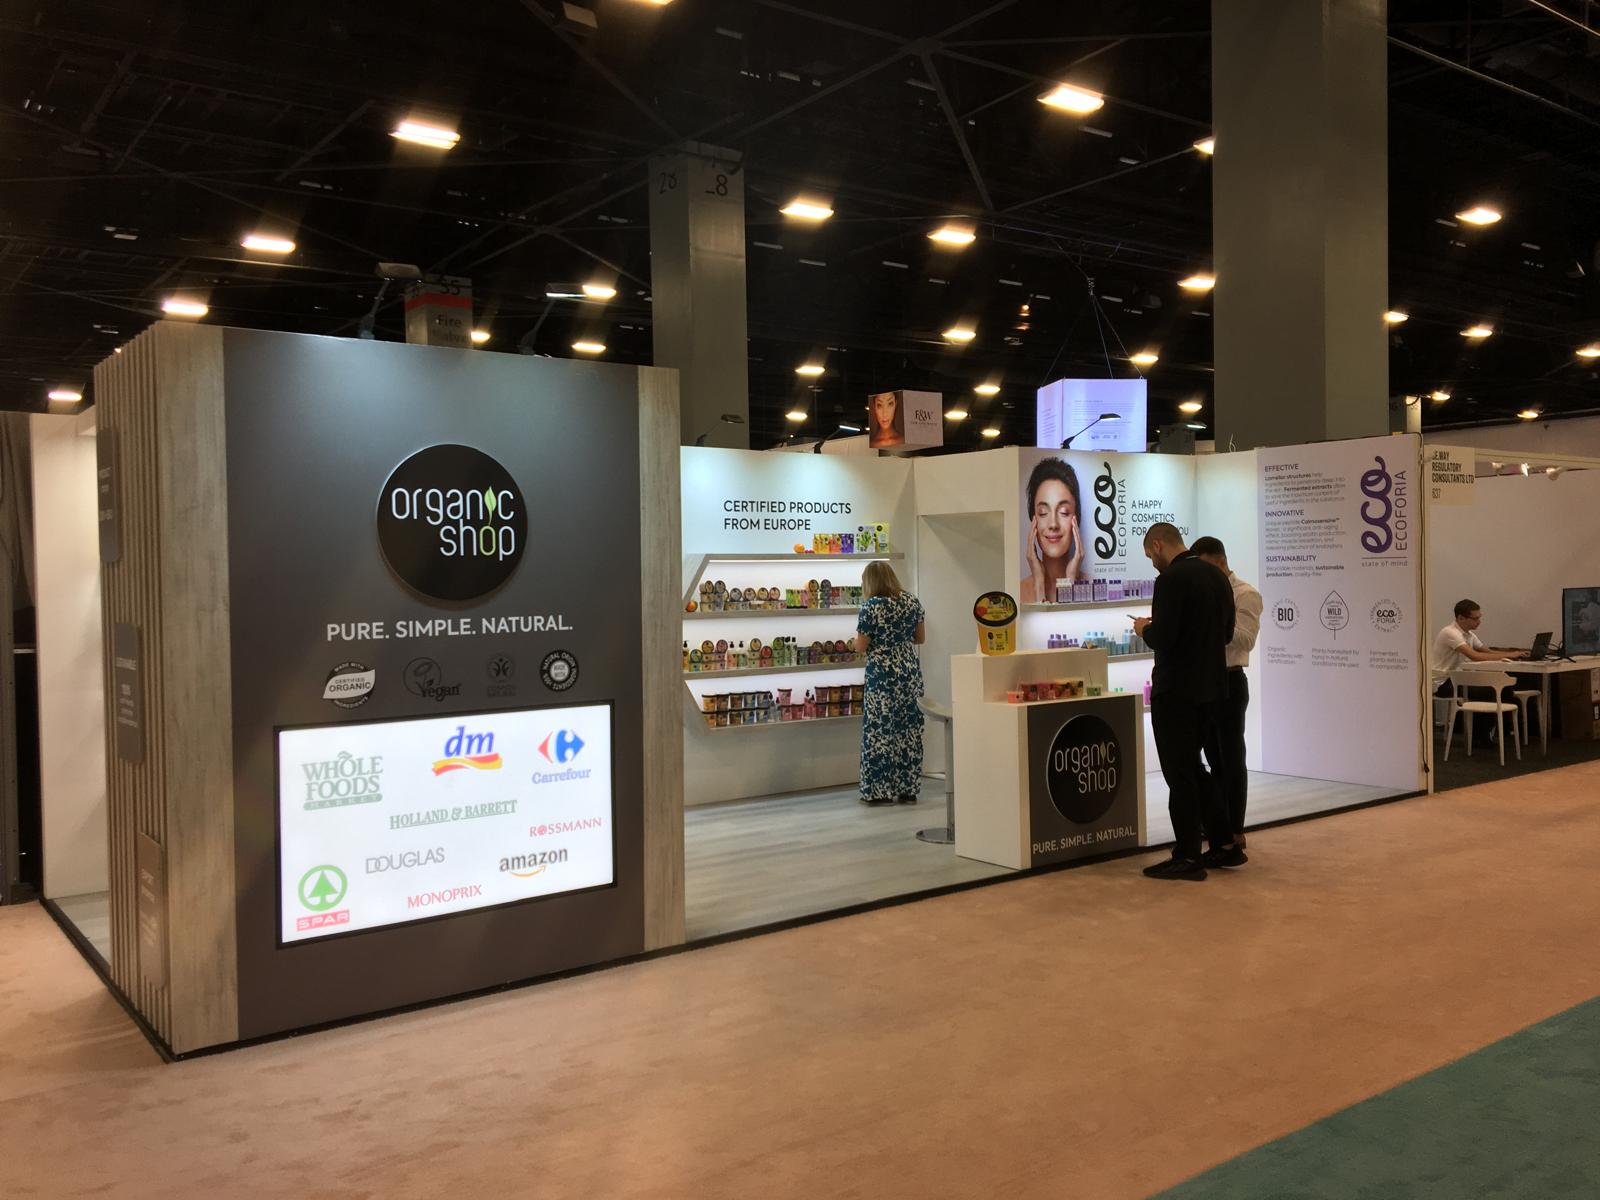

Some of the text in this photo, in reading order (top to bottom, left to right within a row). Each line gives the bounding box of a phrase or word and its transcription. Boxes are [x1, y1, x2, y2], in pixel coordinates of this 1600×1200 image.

[1265, 464, 1299, 472] EFFECTIVE
[1432, 473, 1474, 484] CONSULTANTS LTD
[391, 486, 514, 525] organic
[724, 500, 852, 514] CERTIFIED PRODUCTS
[1131, 500, 1162, 510] A HAPPY
[1265, 509, 1304, 517] INNOVATIVE
[1394, 470, 1408, 551] ECOFORIA
[724, 518, 811, 531] FROM EUROPE
[1118, 479, 1126, 557] ECOFORIA
[1131, 513, 1175, 523] COSMETICS
[440, 519, 515, 561] shop
[1131, 526, 1146, 536] FOR
[1277, 608, 1294, 622] BIO
[1327, 608, 1341, 616] WILD
[1377, 609, 1397, 618] eco
[327, 615, 573, 642] PURE. SIMPLE. NATURAL.
[329, 681, 372, 693] ORGANIC
[416, 679, 461, 701] Vegan
[444, 726, 495, 758] dm
[301, 751, 384, 781] WHOLE
[1055, 740, 1116, 773] organic
[532, 768, 592, 784] Carrefour
[1078, 766, 1117, 794] shop
[305, 775, 381, 801] FOODS
[390, 800, 518, 829] HOLLAND & BARRETT
[529, 818, 603, 837] ROSSMANN
[1032, 825, 1137, 854] PURE. SIMPLE. NATURAL.
[366, 848, 446, 874] DOUGLAS
[499, 848, 569, 873] amazon
[407, 885, 483, 909] MONOPRIX
[297, 911, 350, 930] SPAR
